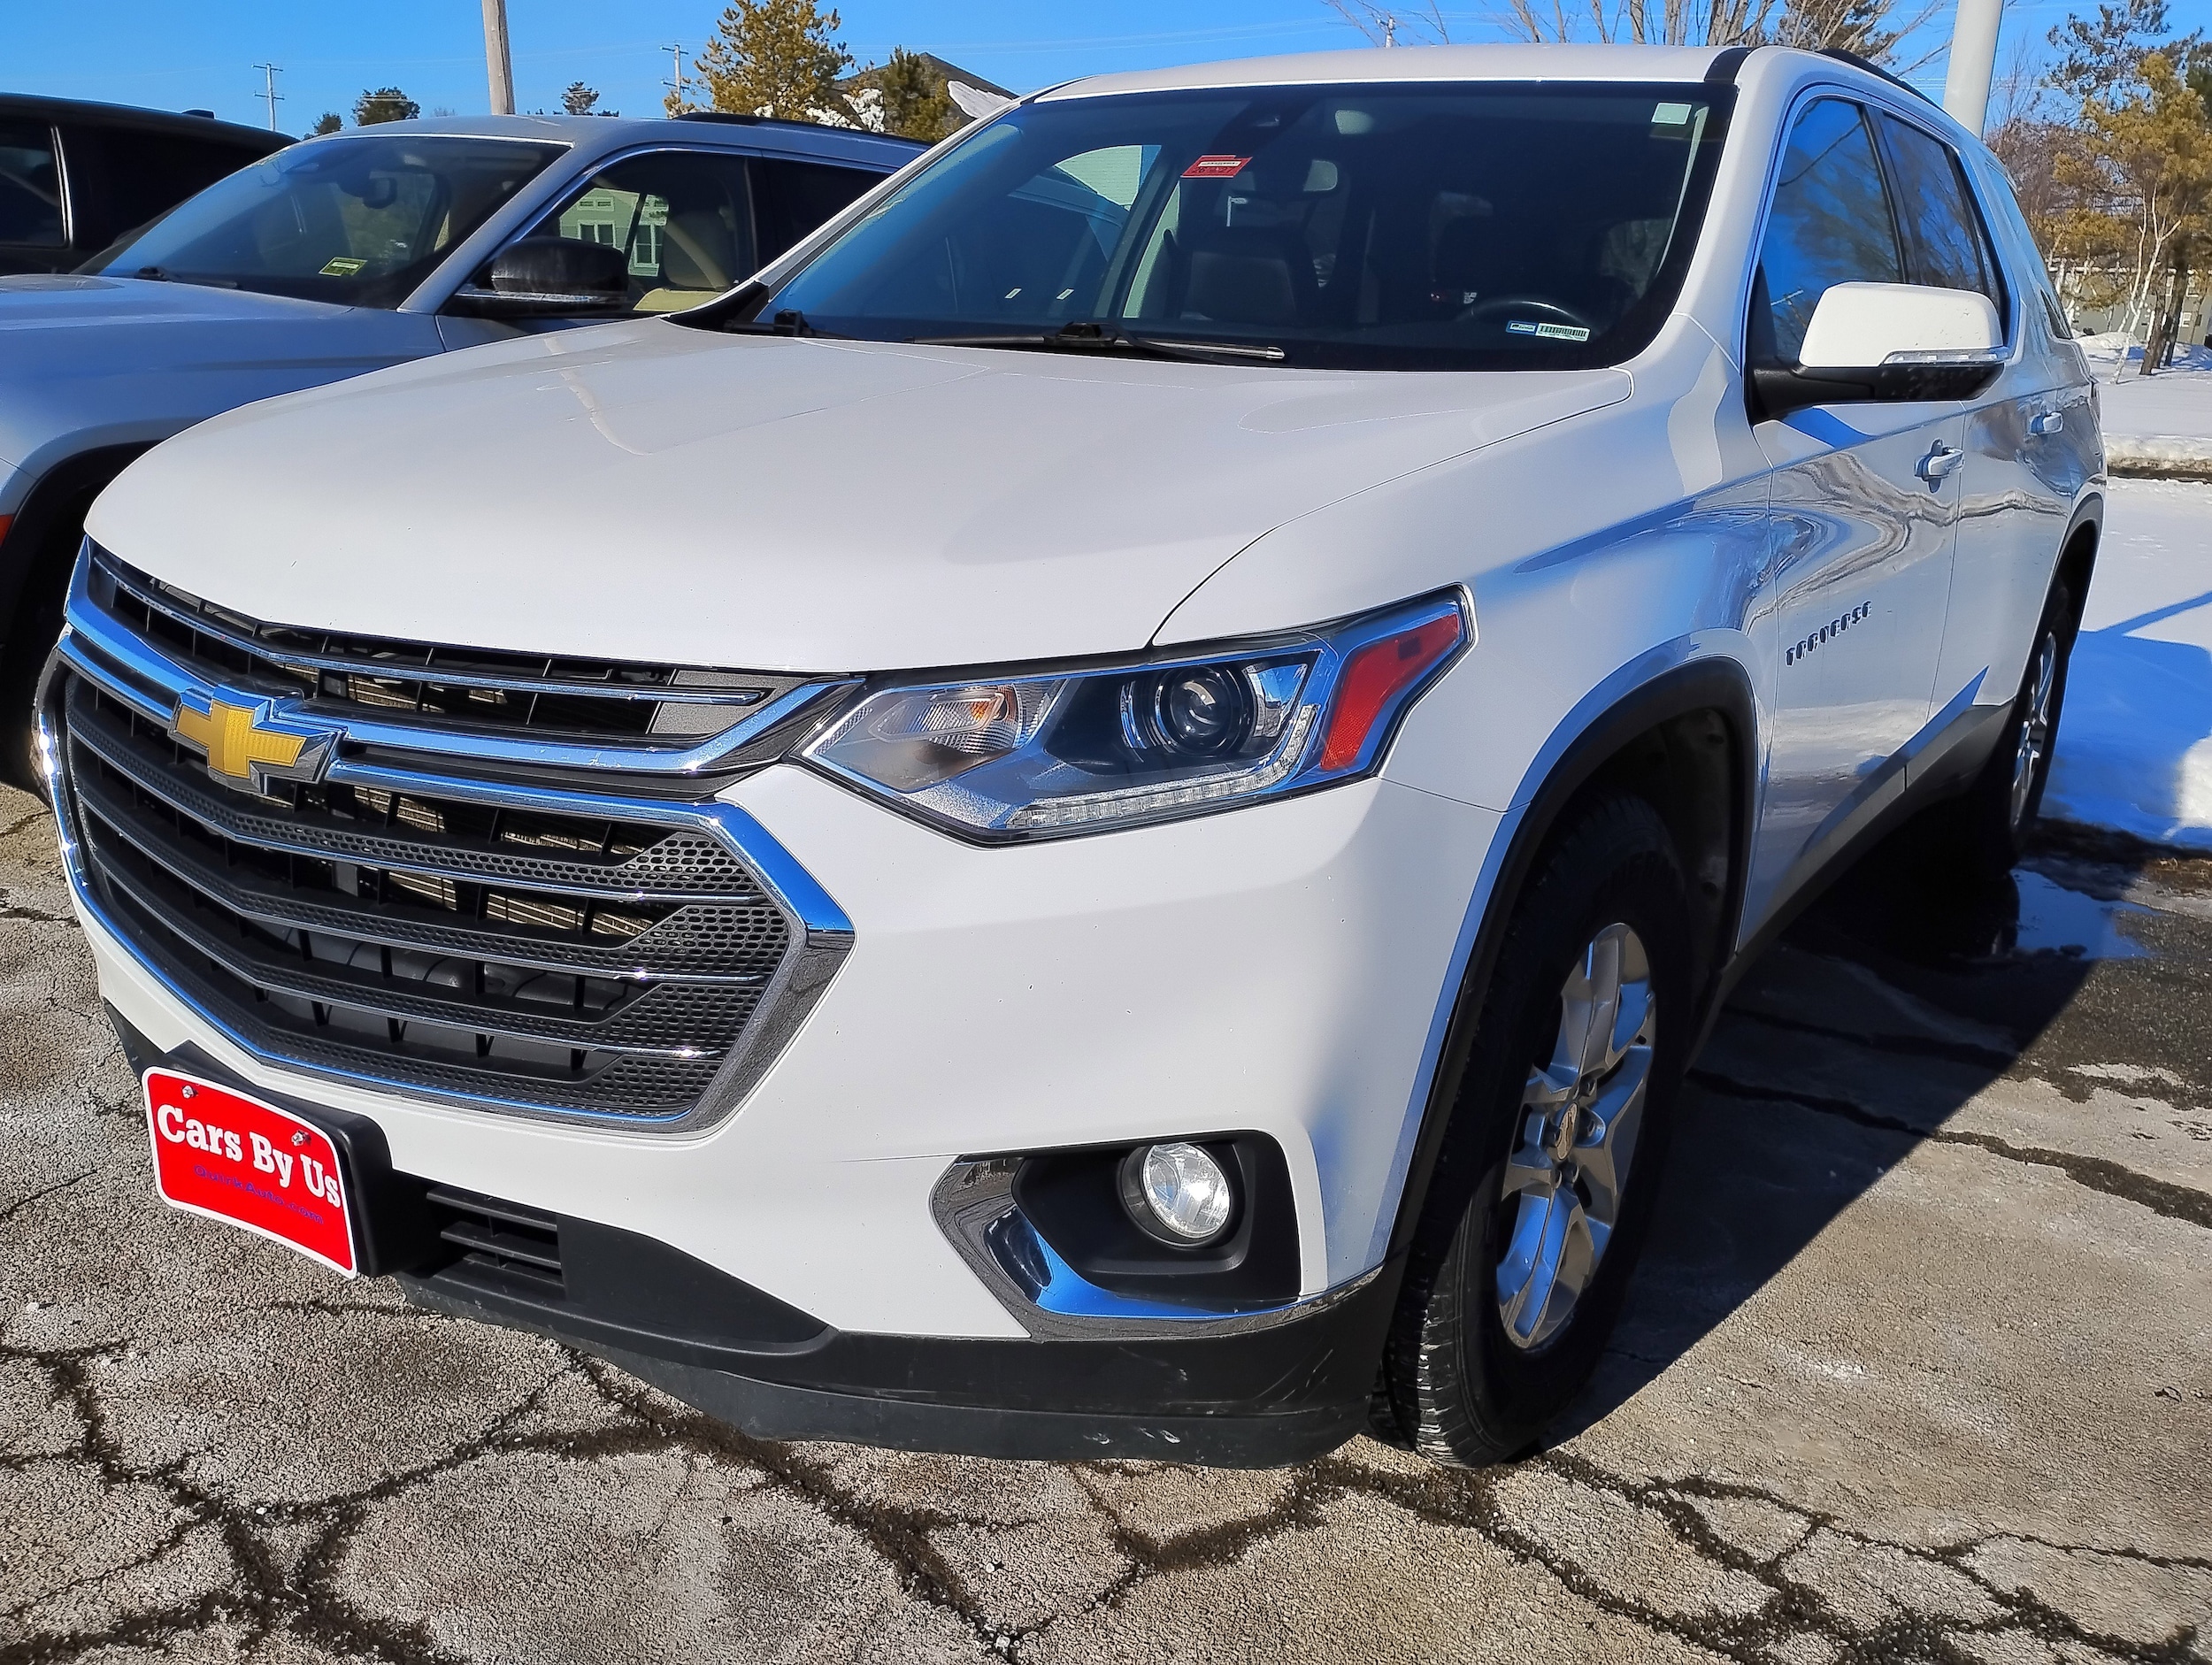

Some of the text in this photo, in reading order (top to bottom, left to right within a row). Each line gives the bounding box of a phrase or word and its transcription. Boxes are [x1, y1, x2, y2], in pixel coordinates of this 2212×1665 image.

[1786, 601, 1872, 666] TRAVERSE
[157, 1104, 342, 1208] Cars By Us
